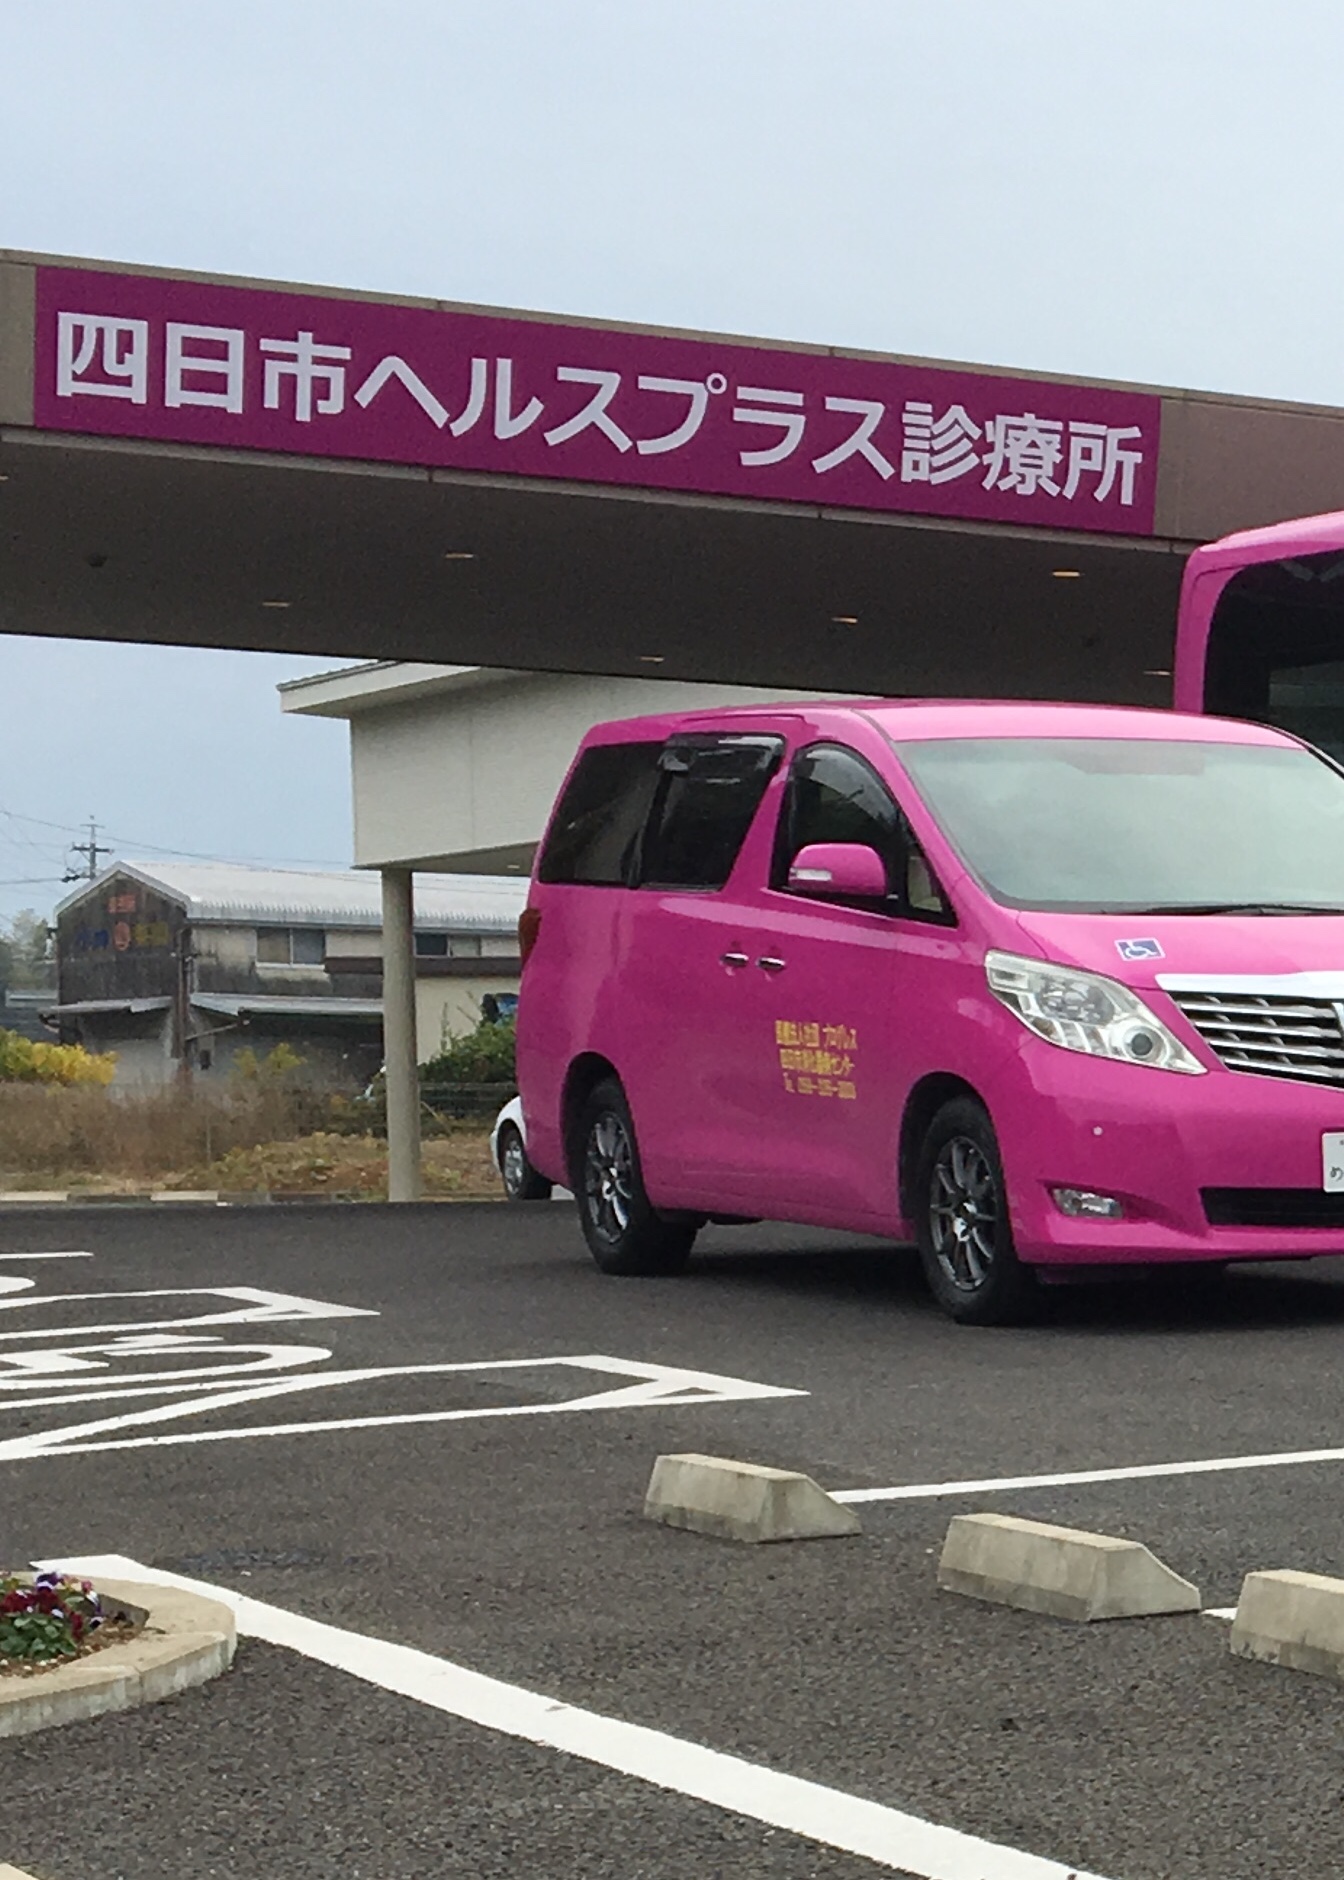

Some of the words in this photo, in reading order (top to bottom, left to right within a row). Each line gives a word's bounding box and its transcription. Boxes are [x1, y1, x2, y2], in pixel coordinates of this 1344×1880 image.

[55, 310, 1145, 507] 四日市ヘルスプラス診療所
